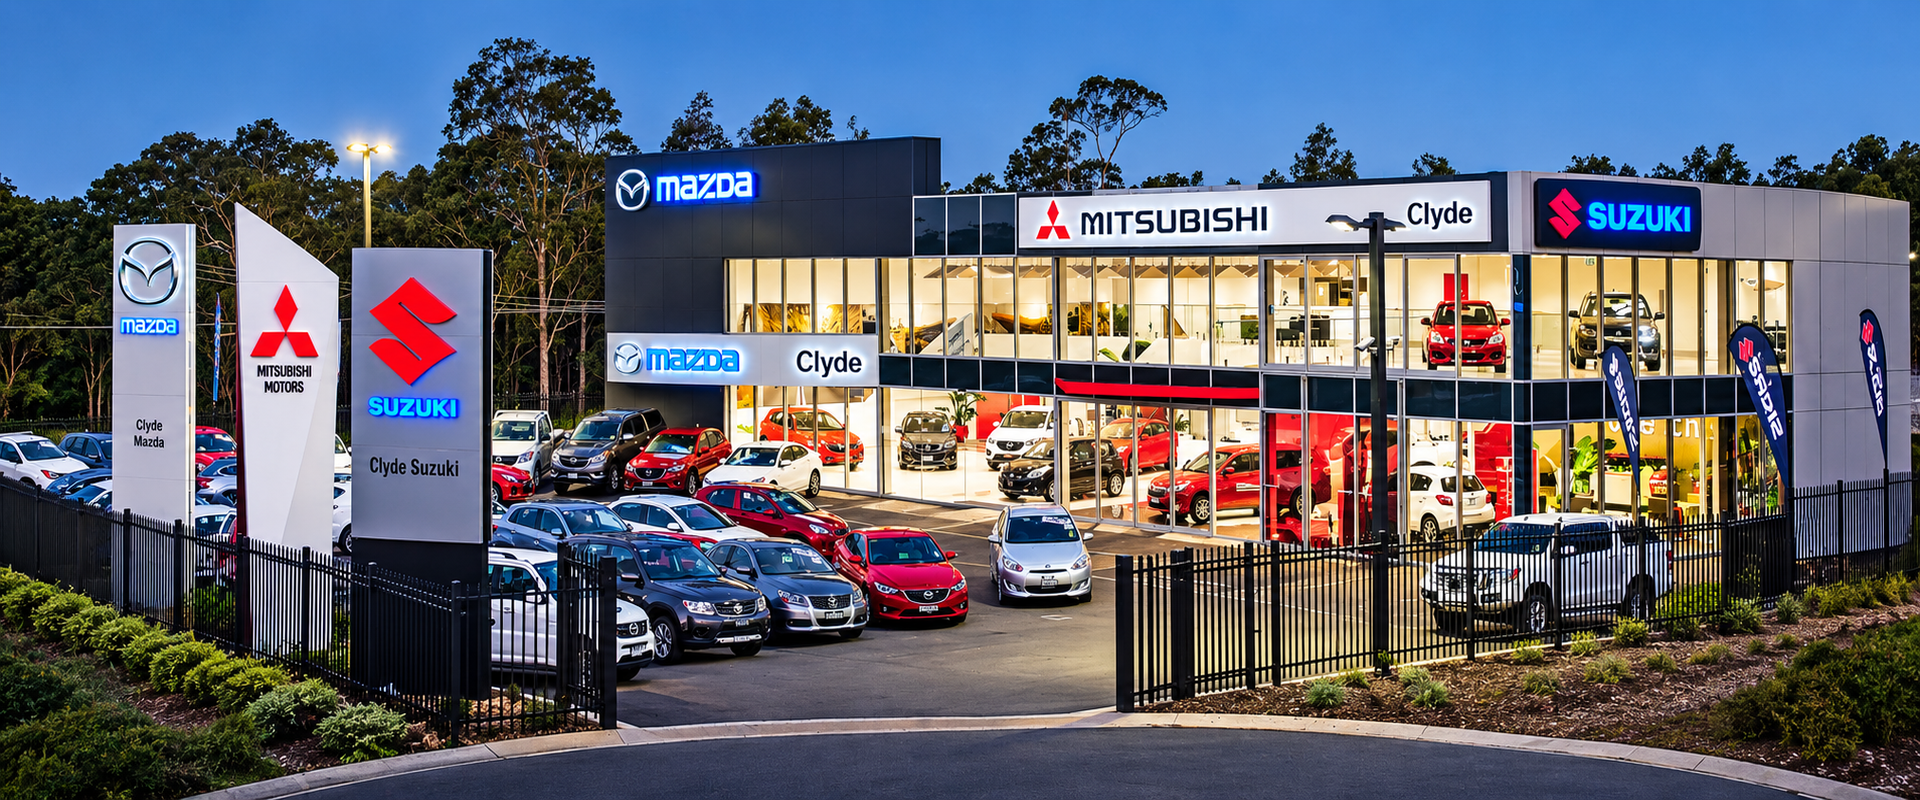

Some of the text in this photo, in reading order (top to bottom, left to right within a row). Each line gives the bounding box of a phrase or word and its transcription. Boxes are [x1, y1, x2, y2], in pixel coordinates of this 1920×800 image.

[655, 171, 754, 203] mazda
[1080, 205, 1268, 236] MITSUBISHI
[1406, 201, 1473, 231] Clyde
[1587, 202, 1691, 233] SUZUKI
[120, 318, 178, 334] mazda
[257, 365, 312, 377] MITSUBISHI
[646, 347, 741, 372] mazda
[796, 350, 862, 378] Clyde
[264, 381, 304, 393] MOTORS
[368, 396, 458, 419] SUZUKI
[135, 419, 163, 434] Clyde
[133, 435, 165, 449] Mazda
[369, 457, 459, 478] Clyde Suzuki
